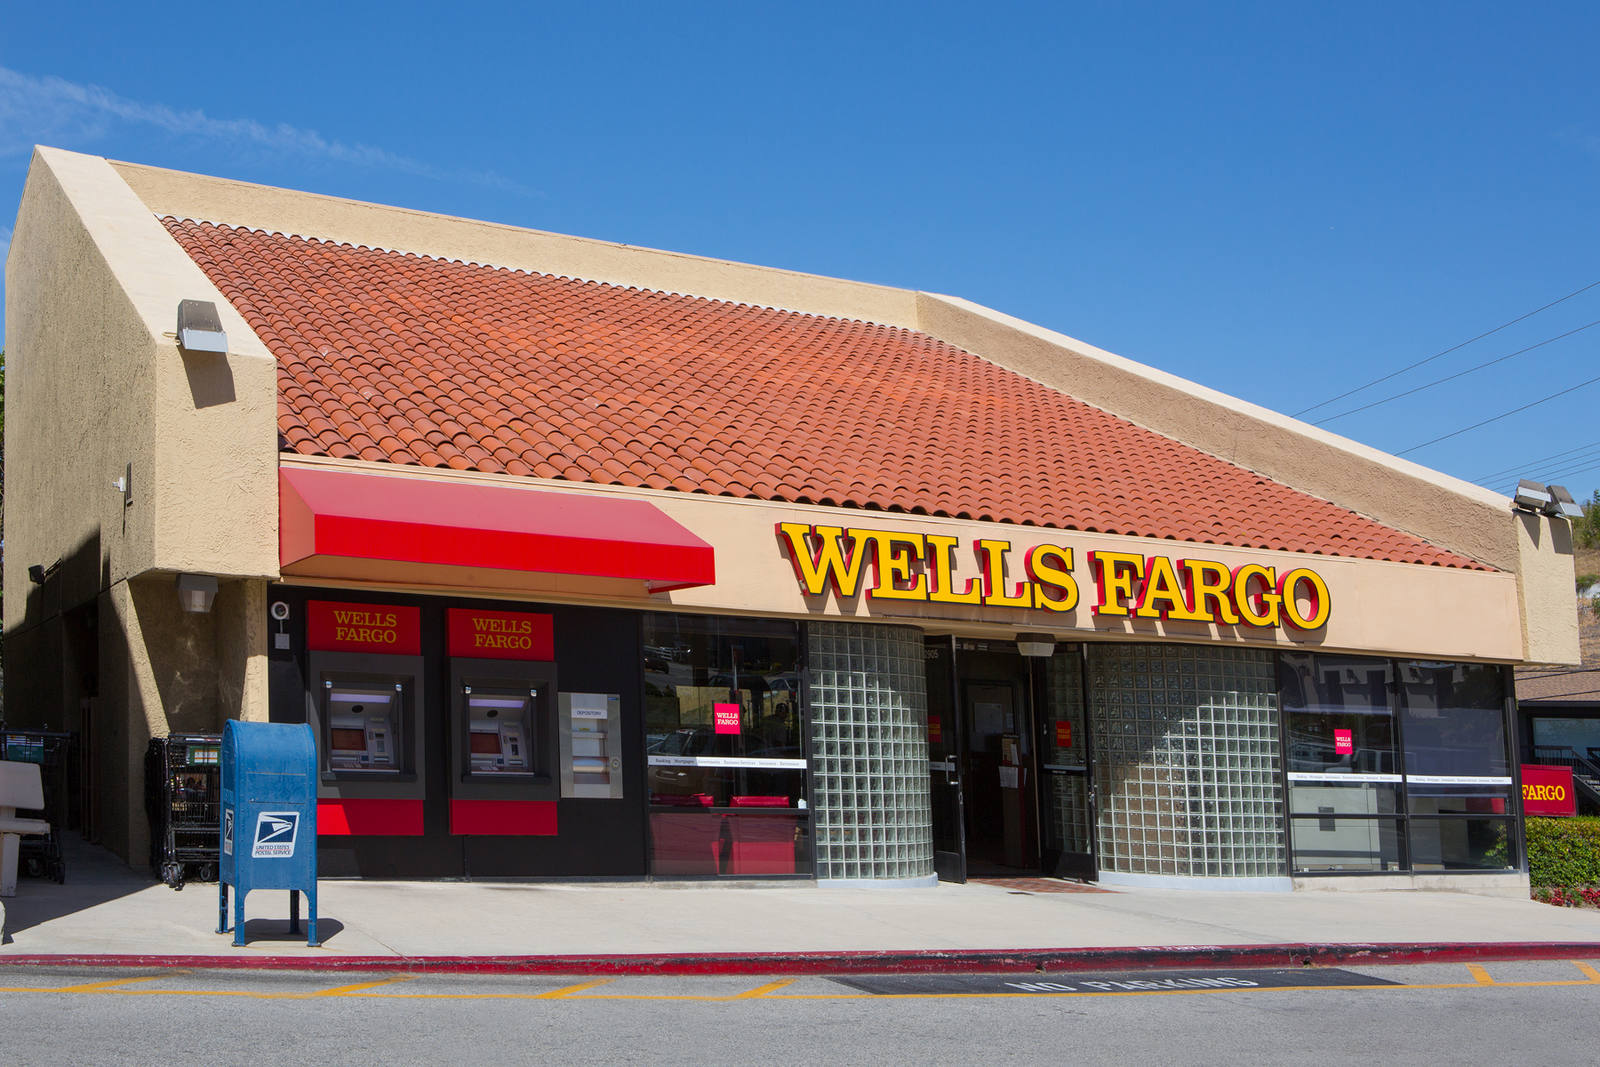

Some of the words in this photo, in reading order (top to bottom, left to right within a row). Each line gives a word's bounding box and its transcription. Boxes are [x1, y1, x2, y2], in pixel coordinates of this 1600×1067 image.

[776, 521, 1079, 612] WELLS
[1088, 550, 1331, 631] FARGO
[333, 610, 397, 627] WELLS
[472, 618, 532, 634] WELLS
[335, 627, 397, 643] FARGO
[474, 634, 532, 649] FARGO
[1522, 784, 1566, 801] FARGO
[1004, 981, 1077, 992] NO
[1080, 976, 1260, 991] PARKING
